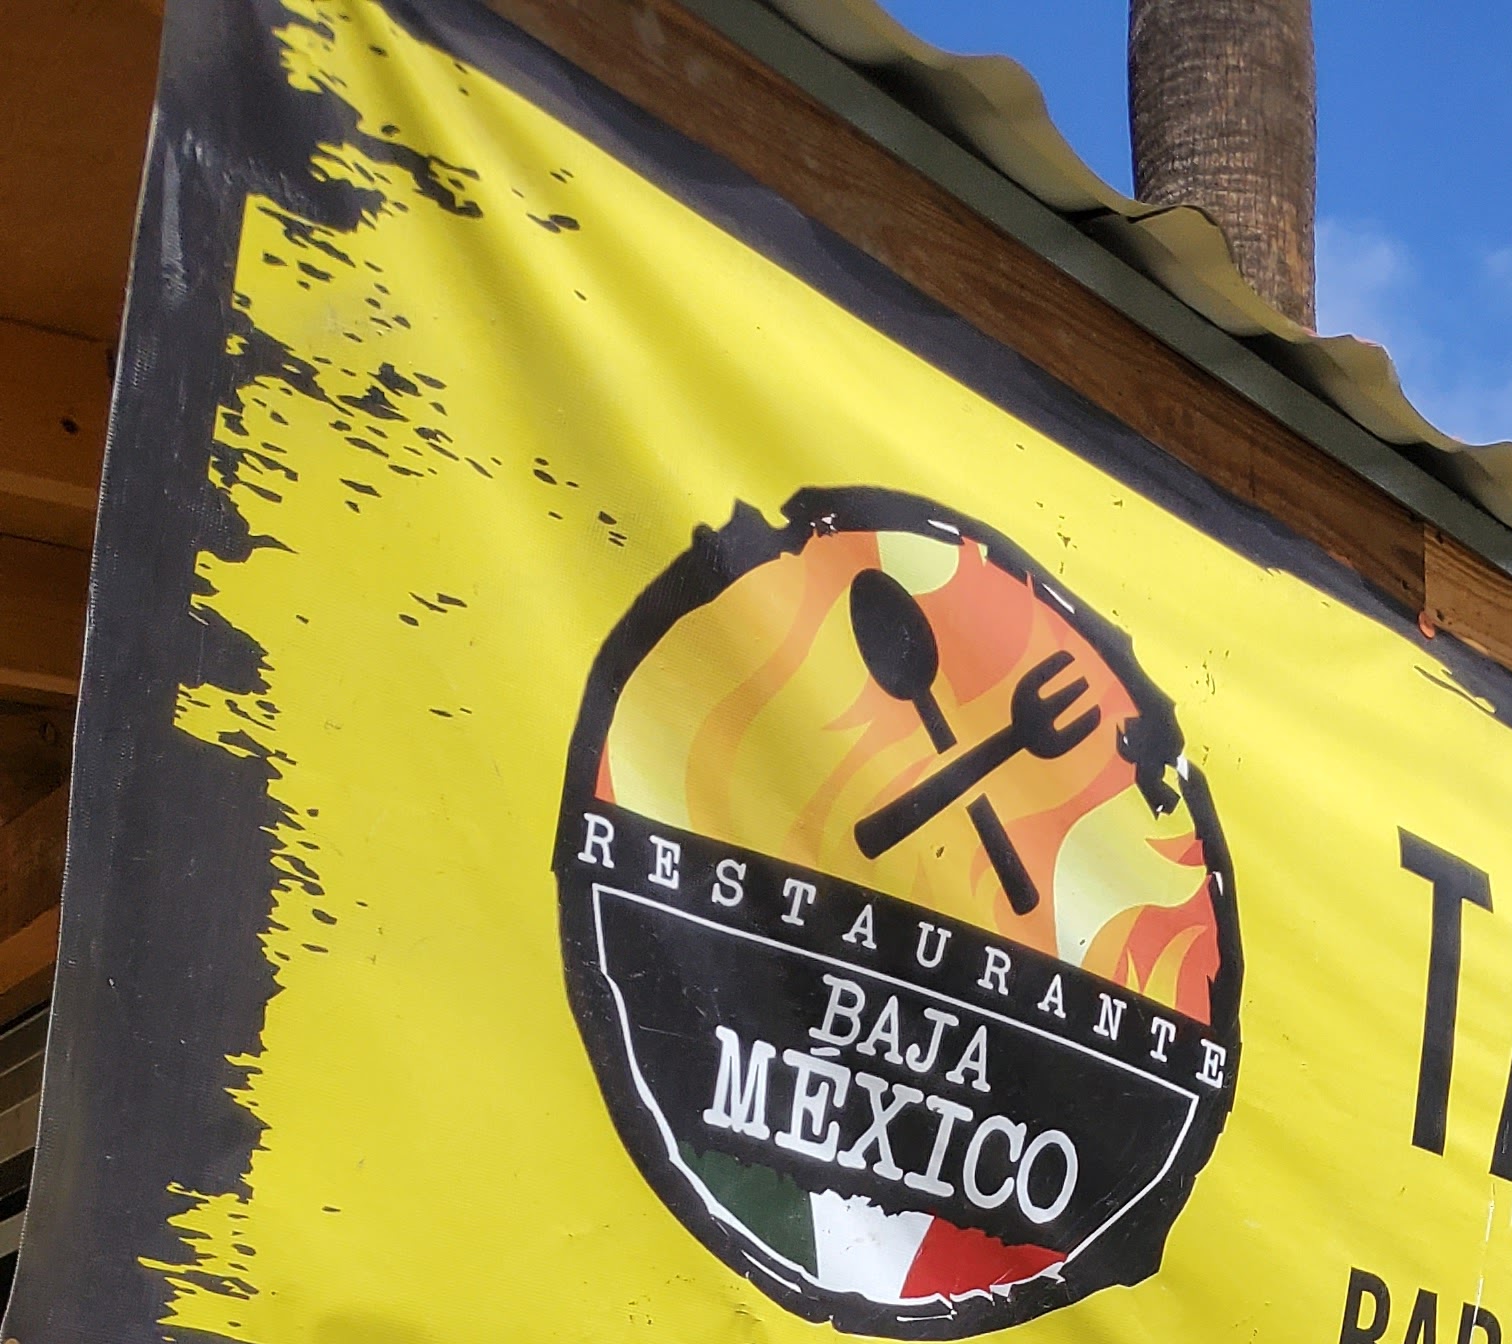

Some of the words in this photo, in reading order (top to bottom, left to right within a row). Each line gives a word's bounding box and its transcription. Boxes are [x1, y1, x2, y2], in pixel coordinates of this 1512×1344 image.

[578, 812, 1228, 1089] RESTAURANTE
[810, 974, 991, 1094] BAJA
[702, 1025, 1079, 1224] MÉXICO
